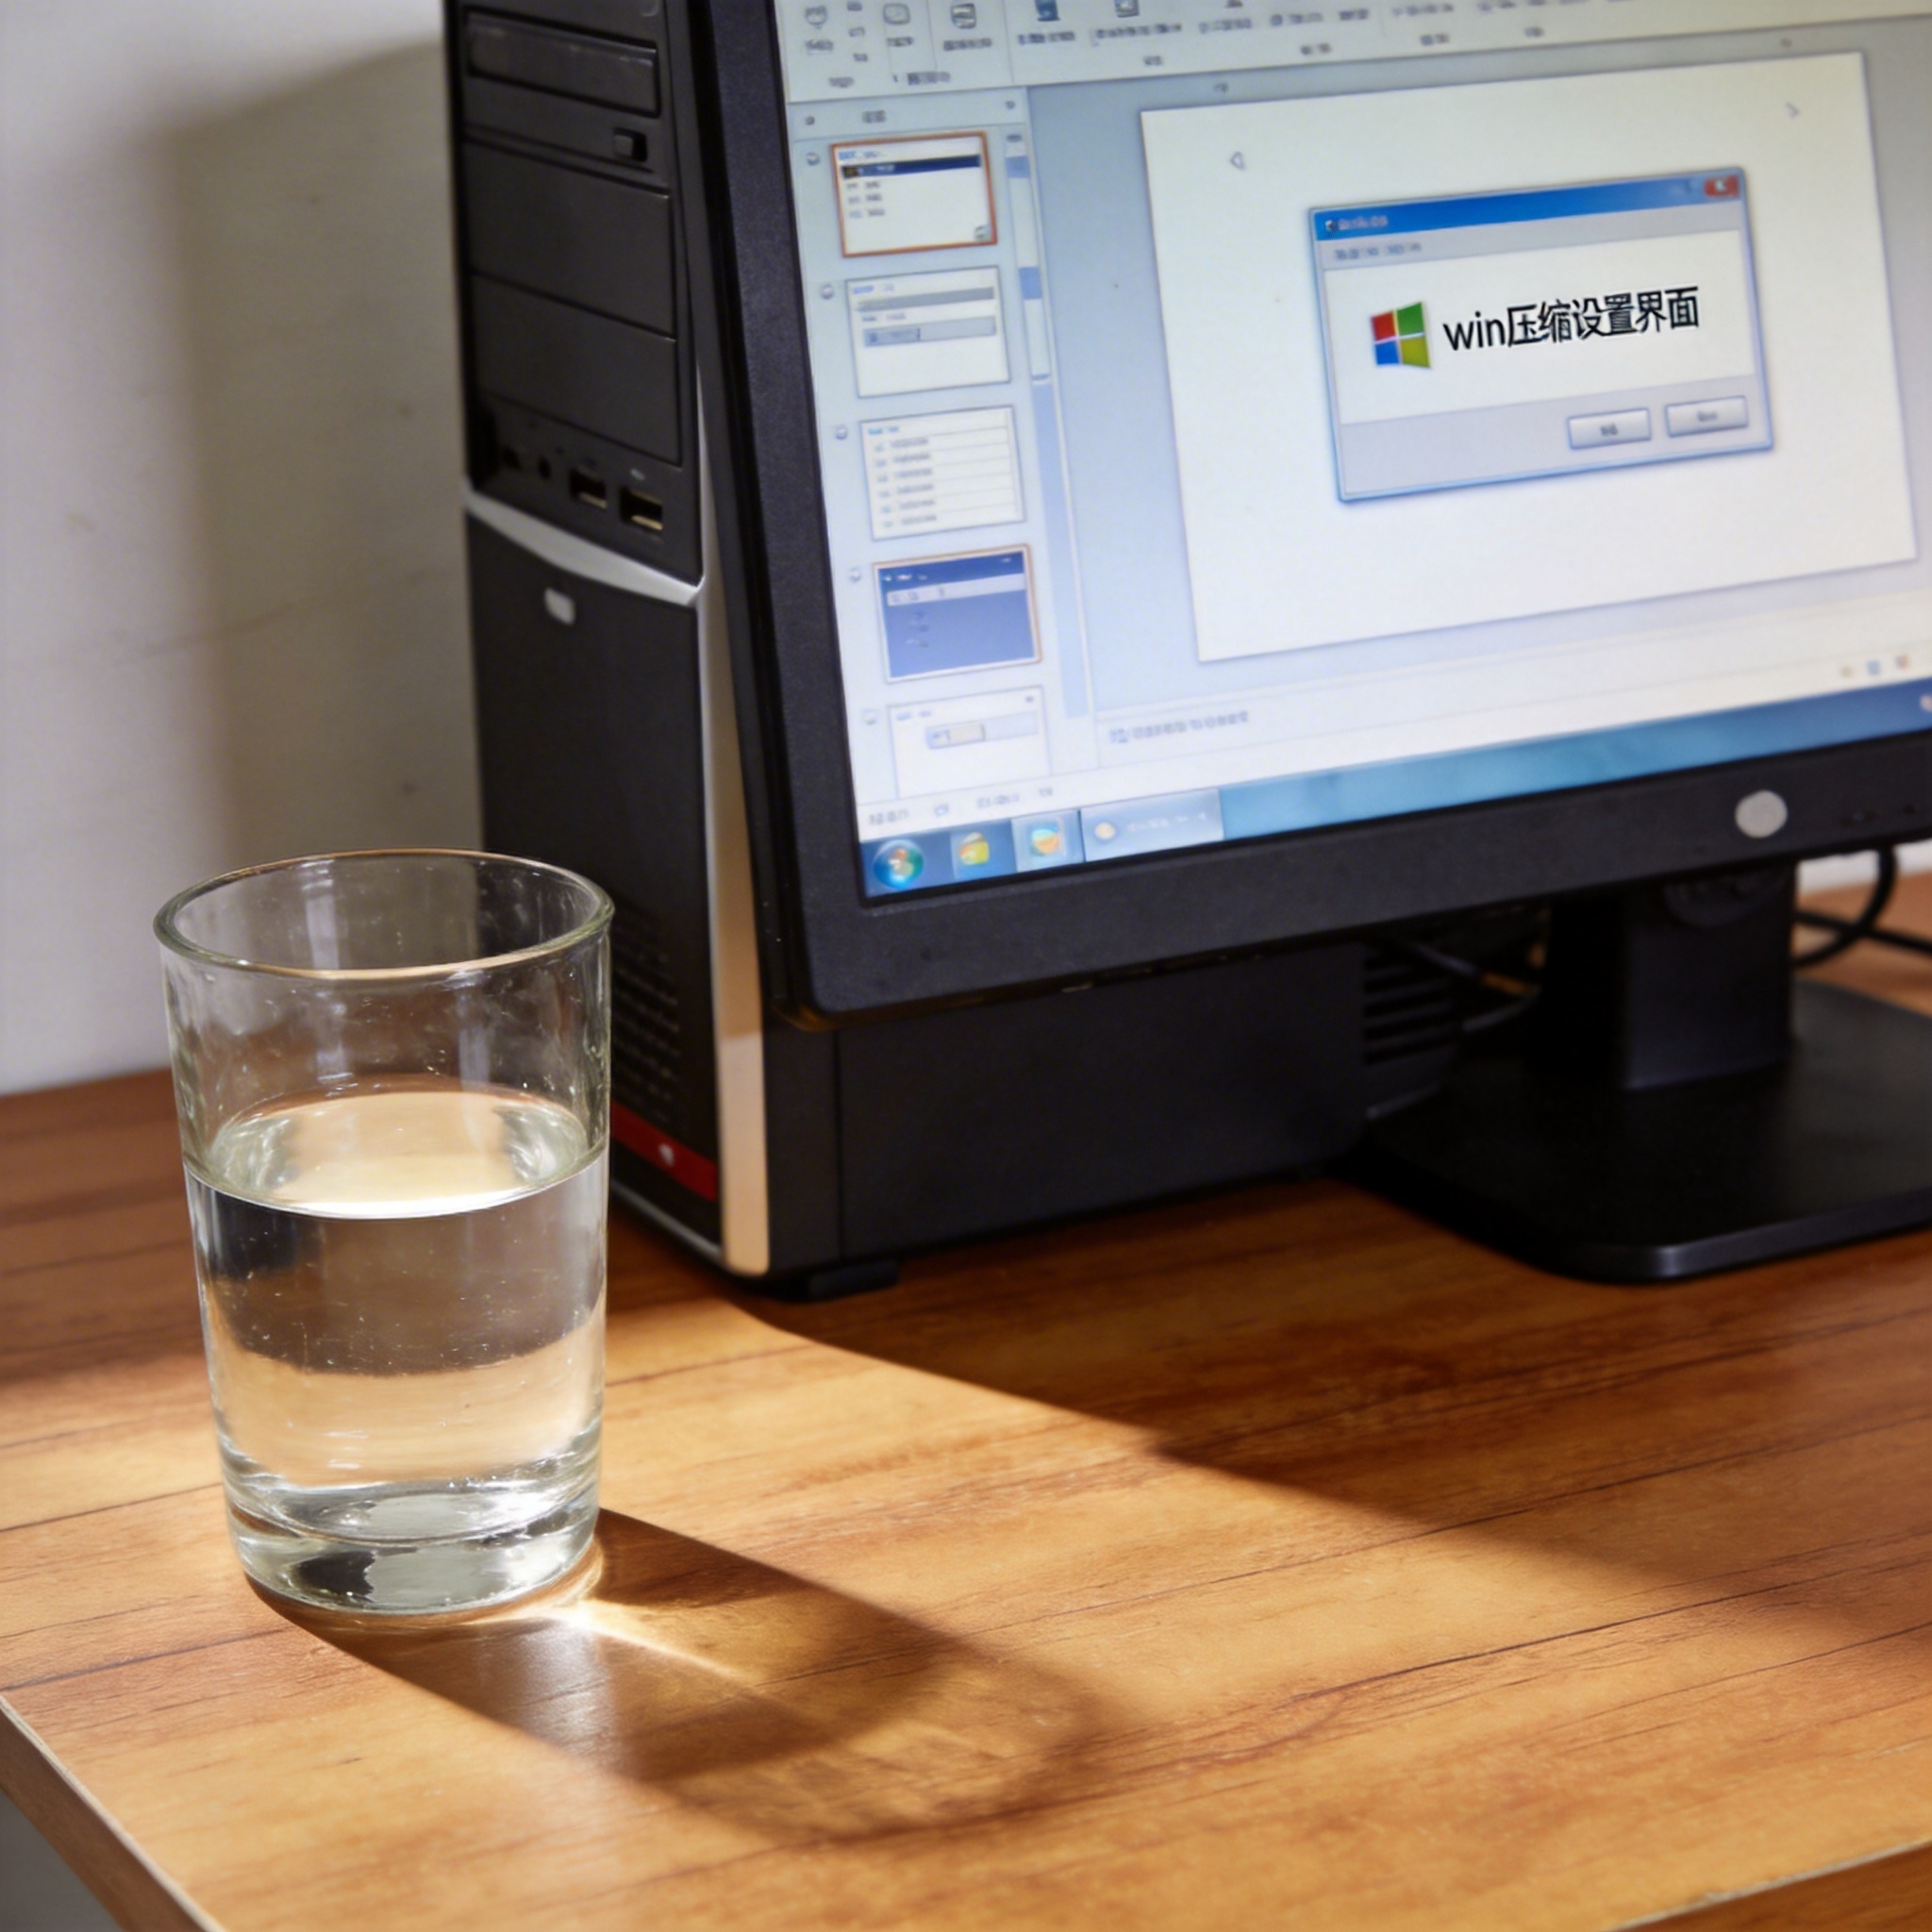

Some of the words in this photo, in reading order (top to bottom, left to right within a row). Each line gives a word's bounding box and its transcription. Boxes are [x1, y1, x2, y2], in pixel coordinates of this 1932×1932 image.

[1443, 286, 1699, 350] win压缩设置界面
